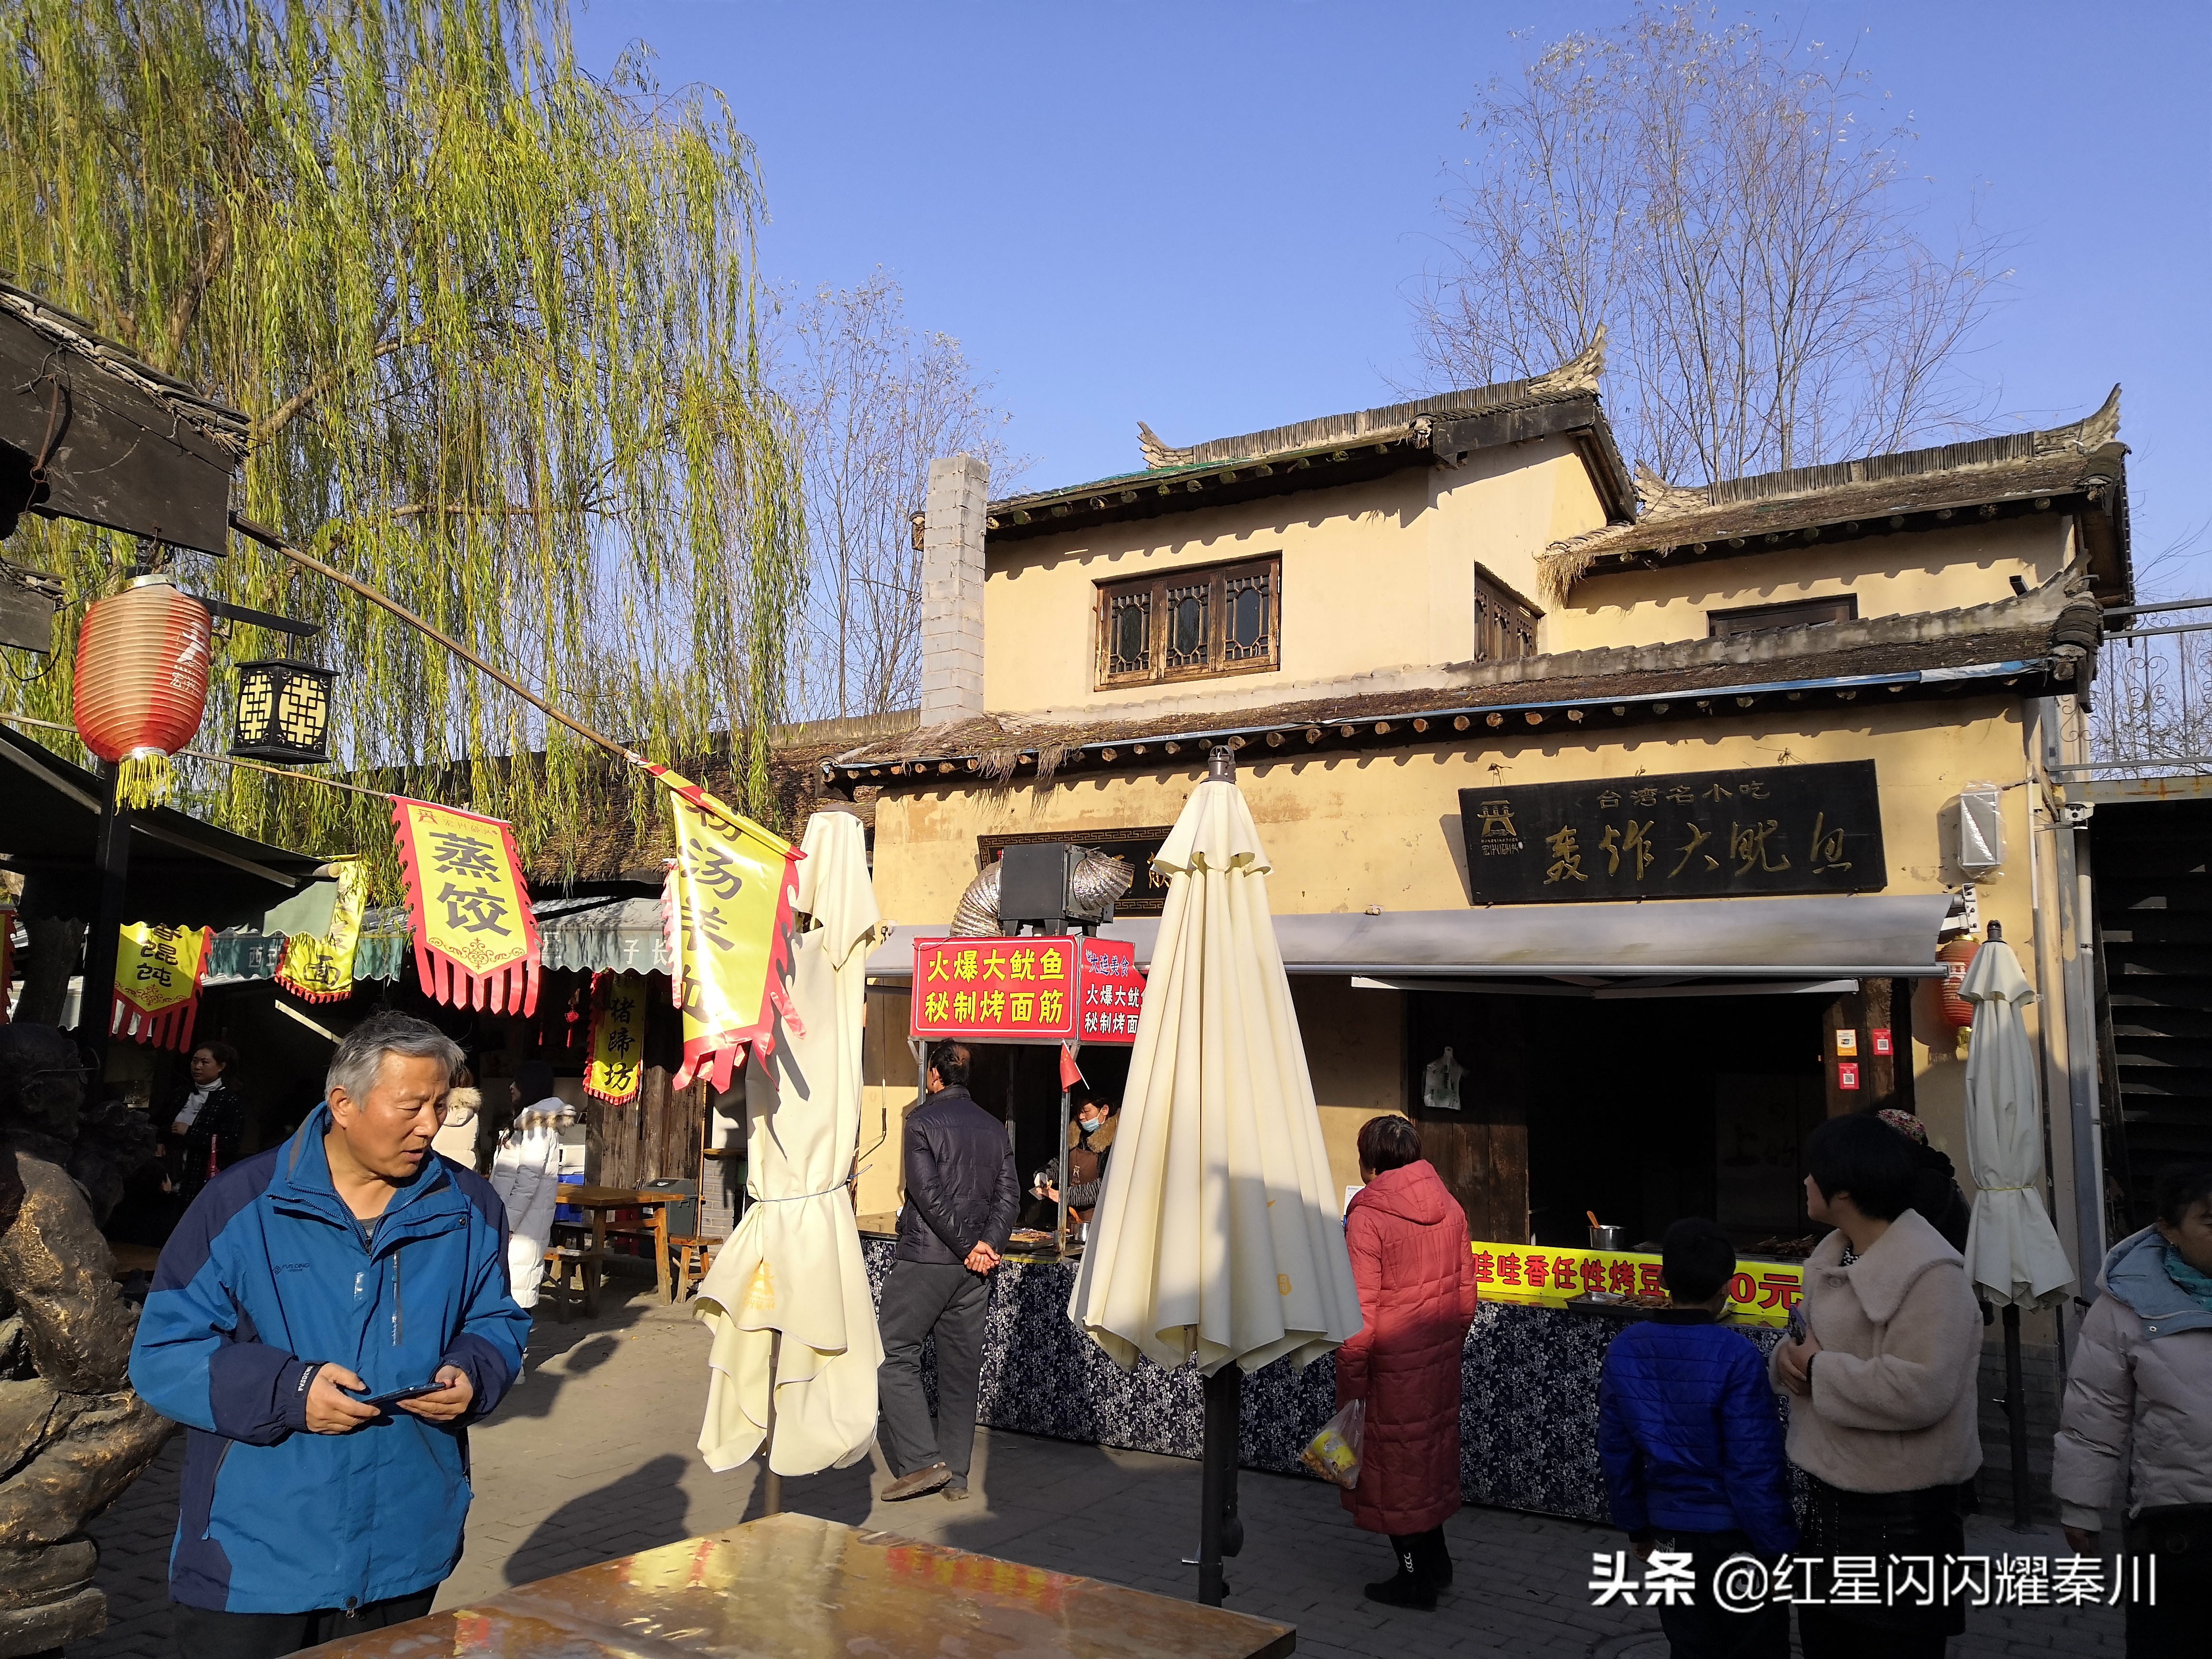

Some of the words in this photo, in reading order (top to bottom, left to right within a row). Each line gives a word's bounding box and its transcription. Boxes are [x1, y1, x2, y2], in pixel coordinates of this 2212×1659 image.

[1596, 781, 1771, 809] 台湾名小吃
[1543, 812, 1852, 884] 轰炸大鱿鱼
[429, 831, 512, 937] 蒸饺
[927, 947, 1064, 983] 火爆大鱿鱼
[925, 989, 1064, 1024] 秘制烤面筋
[1086, 983, 1144, 1009] 火爆大鱿
[603, 996, 636, 1091] 猪蹄坊
